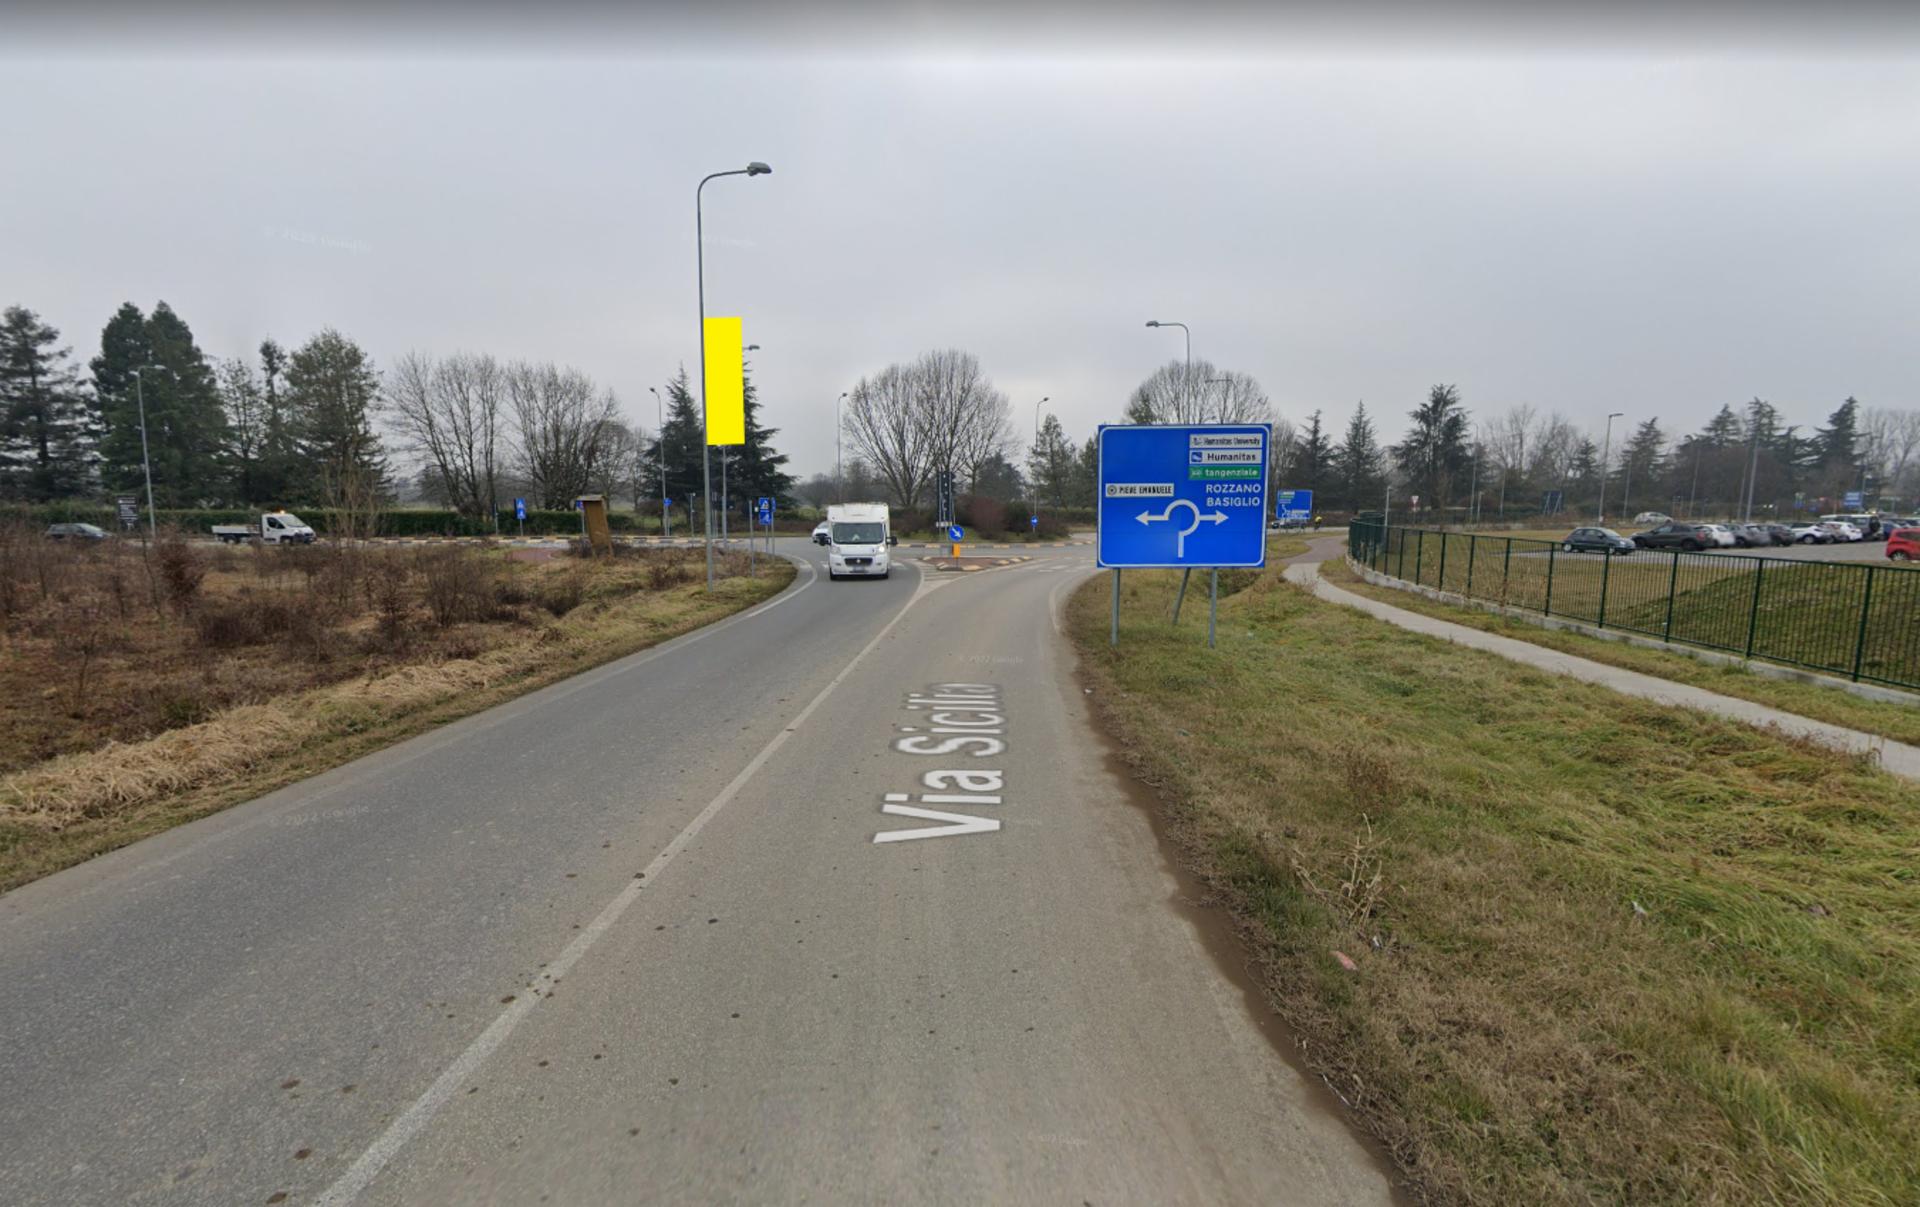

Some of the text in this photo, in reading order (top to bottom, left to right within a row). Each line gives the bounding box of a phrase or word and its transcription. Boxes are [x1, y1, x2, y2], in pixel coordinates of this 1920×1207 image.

[1207, 453, 1256, 461] Humanitas
[1205, 468, 1258, 478] tangenziale
[1206, 484, 1261, 493] ROZZANO
[1206, 497, 1260, 507] BASIGLIO
